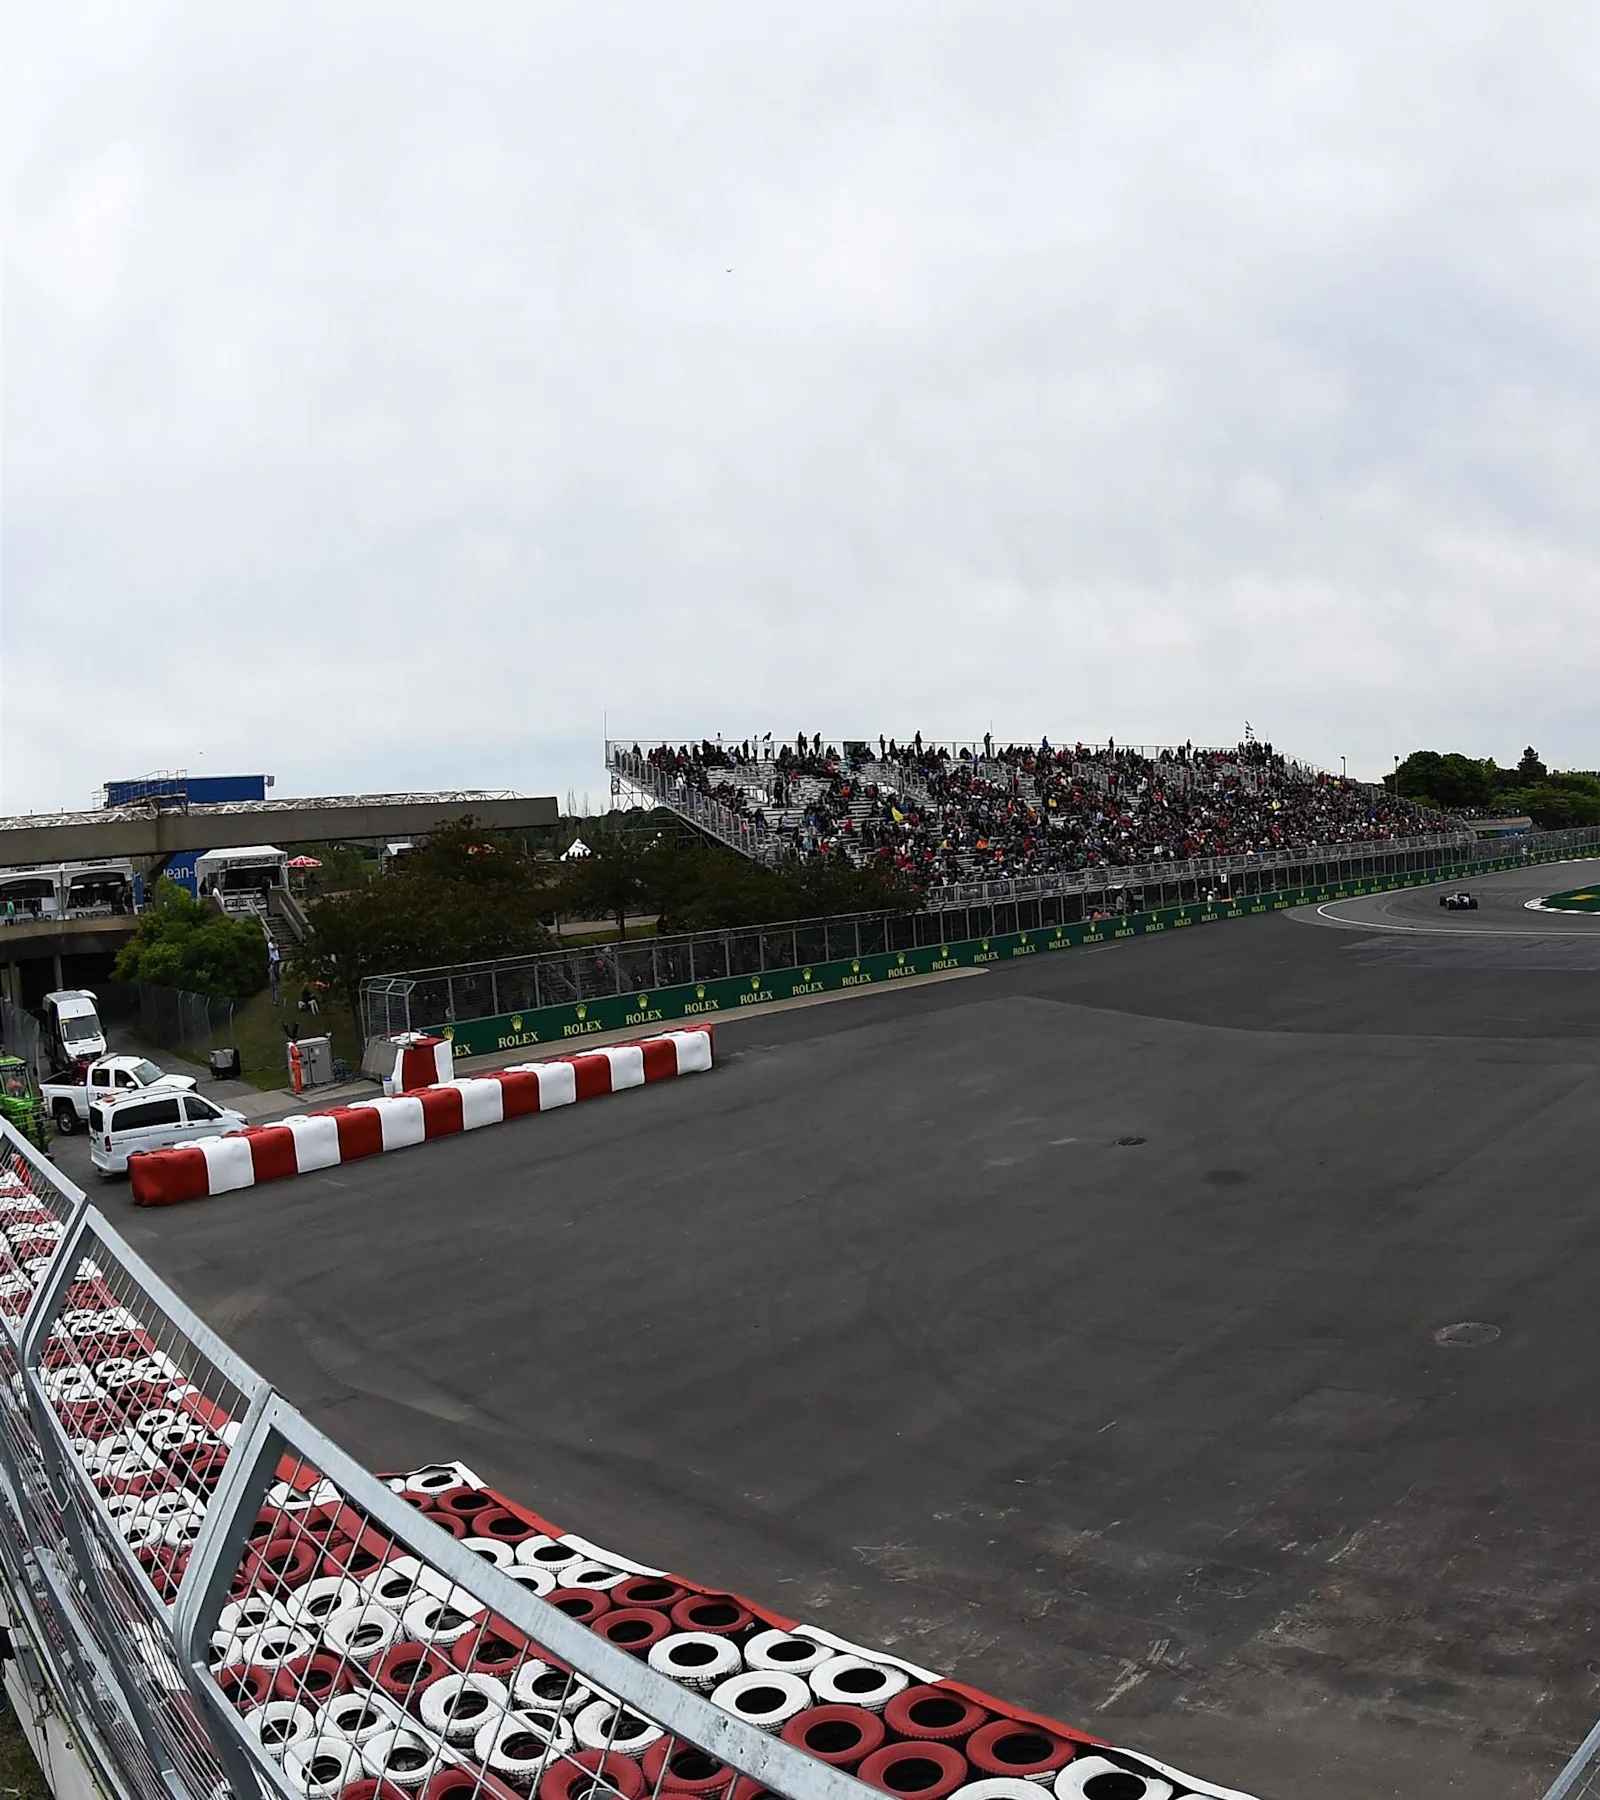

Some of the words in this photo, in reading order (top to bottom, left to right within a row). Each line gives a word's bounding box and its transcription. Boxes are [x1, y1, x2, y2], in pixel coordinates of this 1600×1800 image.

[1174, 917, 1192, 928] ROLEX
[1201, 913, 1218, 922] ROLEX
[1115, 926, 1135, 938] ROLEX
[1146, 921, 1165, 933] ROLEX
[1048, 938, 1071, 950] ROLEX
[1083, 932, 1104, 943] ROLEX
[973, 951, 999, 963] ROLEX
[1013, 944, 1036, 957] ROLEX
[932, 958, 959, 971] ROLEX
[887, 965, 916, 979] ROLEX
[842, 972, 872, 987] ROLEX
[792, 981, 824, 996] ROLEX
[739, 990, 773, 1005] ROLEX
[684, 999, 720, 1015] ROLEX
[625, 1009, 663, 1025] ROLEX
[563, 1019, 602, 1037] ROLEX
[498, 1031, 539, 1049] ROLEX
